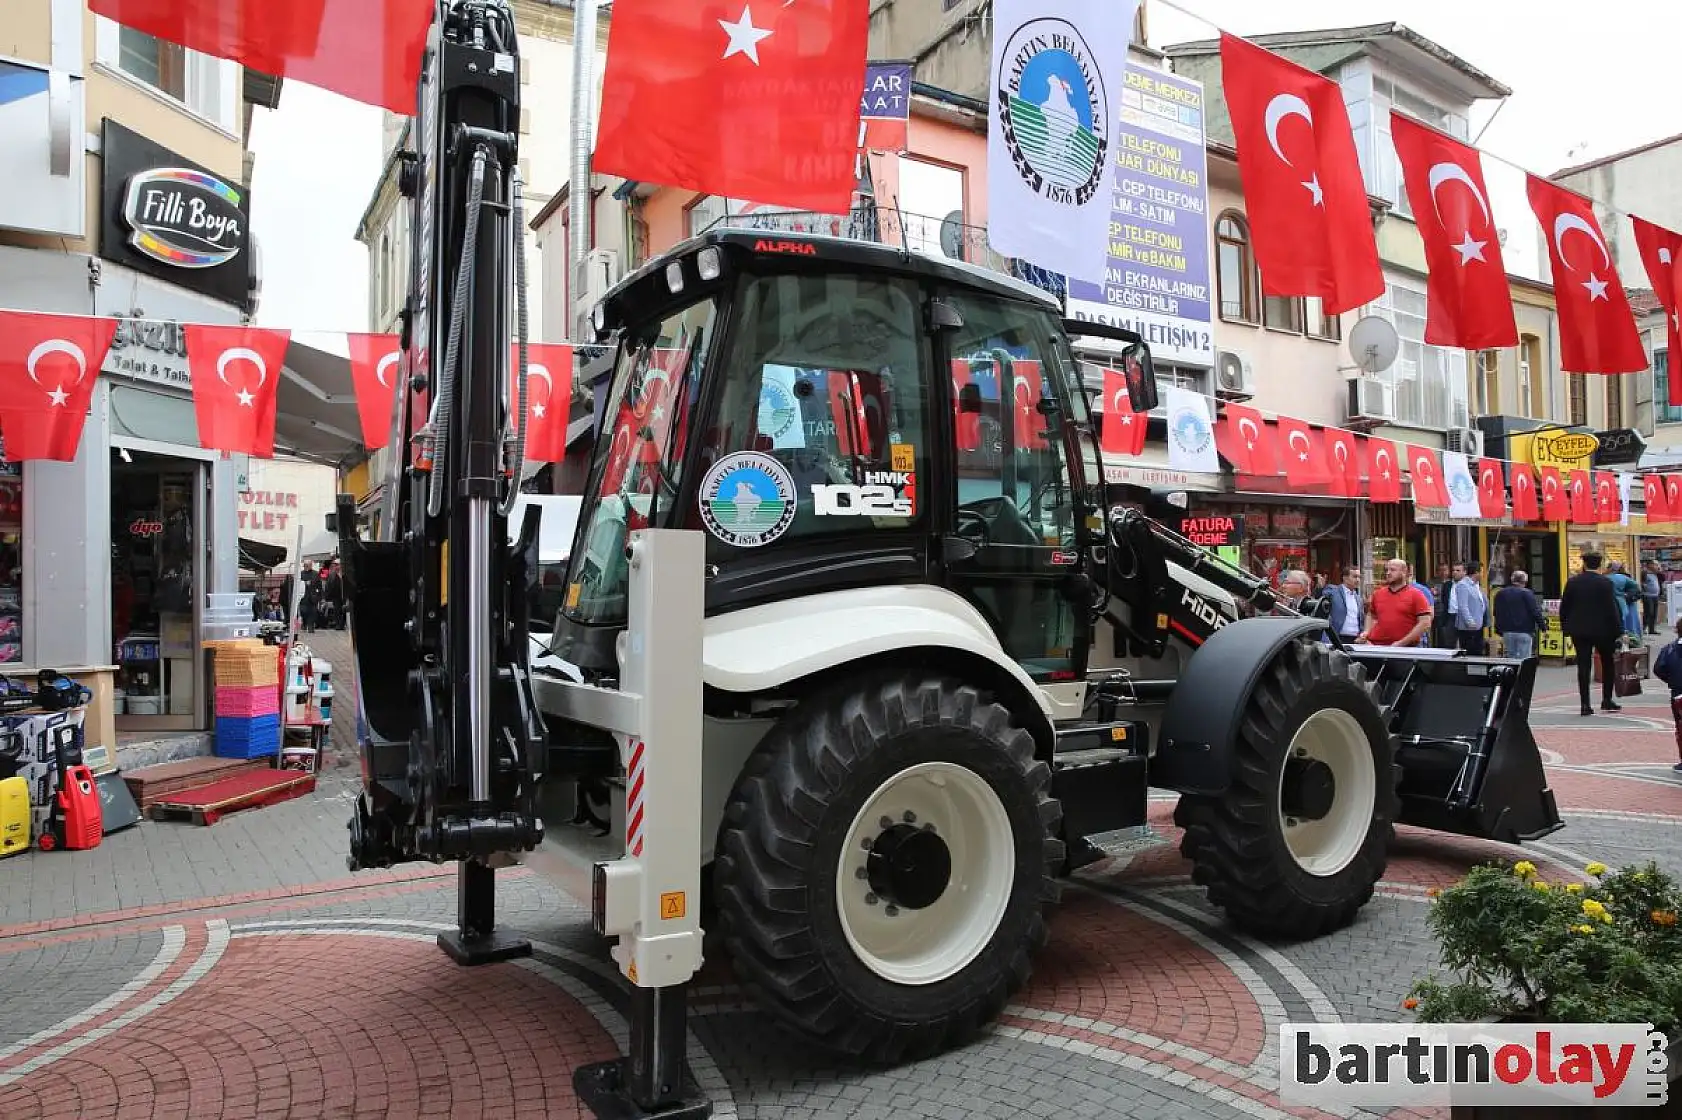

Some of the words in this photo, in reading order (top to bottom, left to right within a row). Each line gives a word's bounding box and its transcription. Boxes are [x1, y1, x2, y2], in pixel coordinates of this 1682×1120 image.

[1009, 35, 1048, 92] BARTIN
[1123, 71, 1154, 92] DEME
[1120, 132, 1182, 162] TELEFONU
[1116, 151, 1143, 169] UAR
[1045, 184, 1072, 204] 1876
[1123, 179, 1146, 196] CEP
[1147, 184, 1204, 213] TELEFONU
[143, 190, 186, 224] Filli
[188, 198, 241, 242] Boya
[1111, 196, 1132, 213] LIM
[1139, 202, 1176, 225] SATIM
[1108, 222, 1121, 236] EP
[1124, 224, 1183, 251] TELEFONU
[754, 240, 817, 255] ALPHA
[1136, 249, 1149, 262] ve
[1150, 250, 1186, 271] BAKIM
[1104, 266, 1121, 282] AN
[1125, 271, 1207, 300] EKRANLARINIZ
[1201, 332, 1210, 351] 2
[151, 363, 159, 376] &
[865, 472, 910, 484] HMK
[238, 488, 298, 508] ÖZLER
[130, 518, 163, 538] dyo
[237, 510, 289, 531] TLET
[1181, 517, 1235, 533] FATURA
[1188, 531, 1228, 545] ÖDEME
